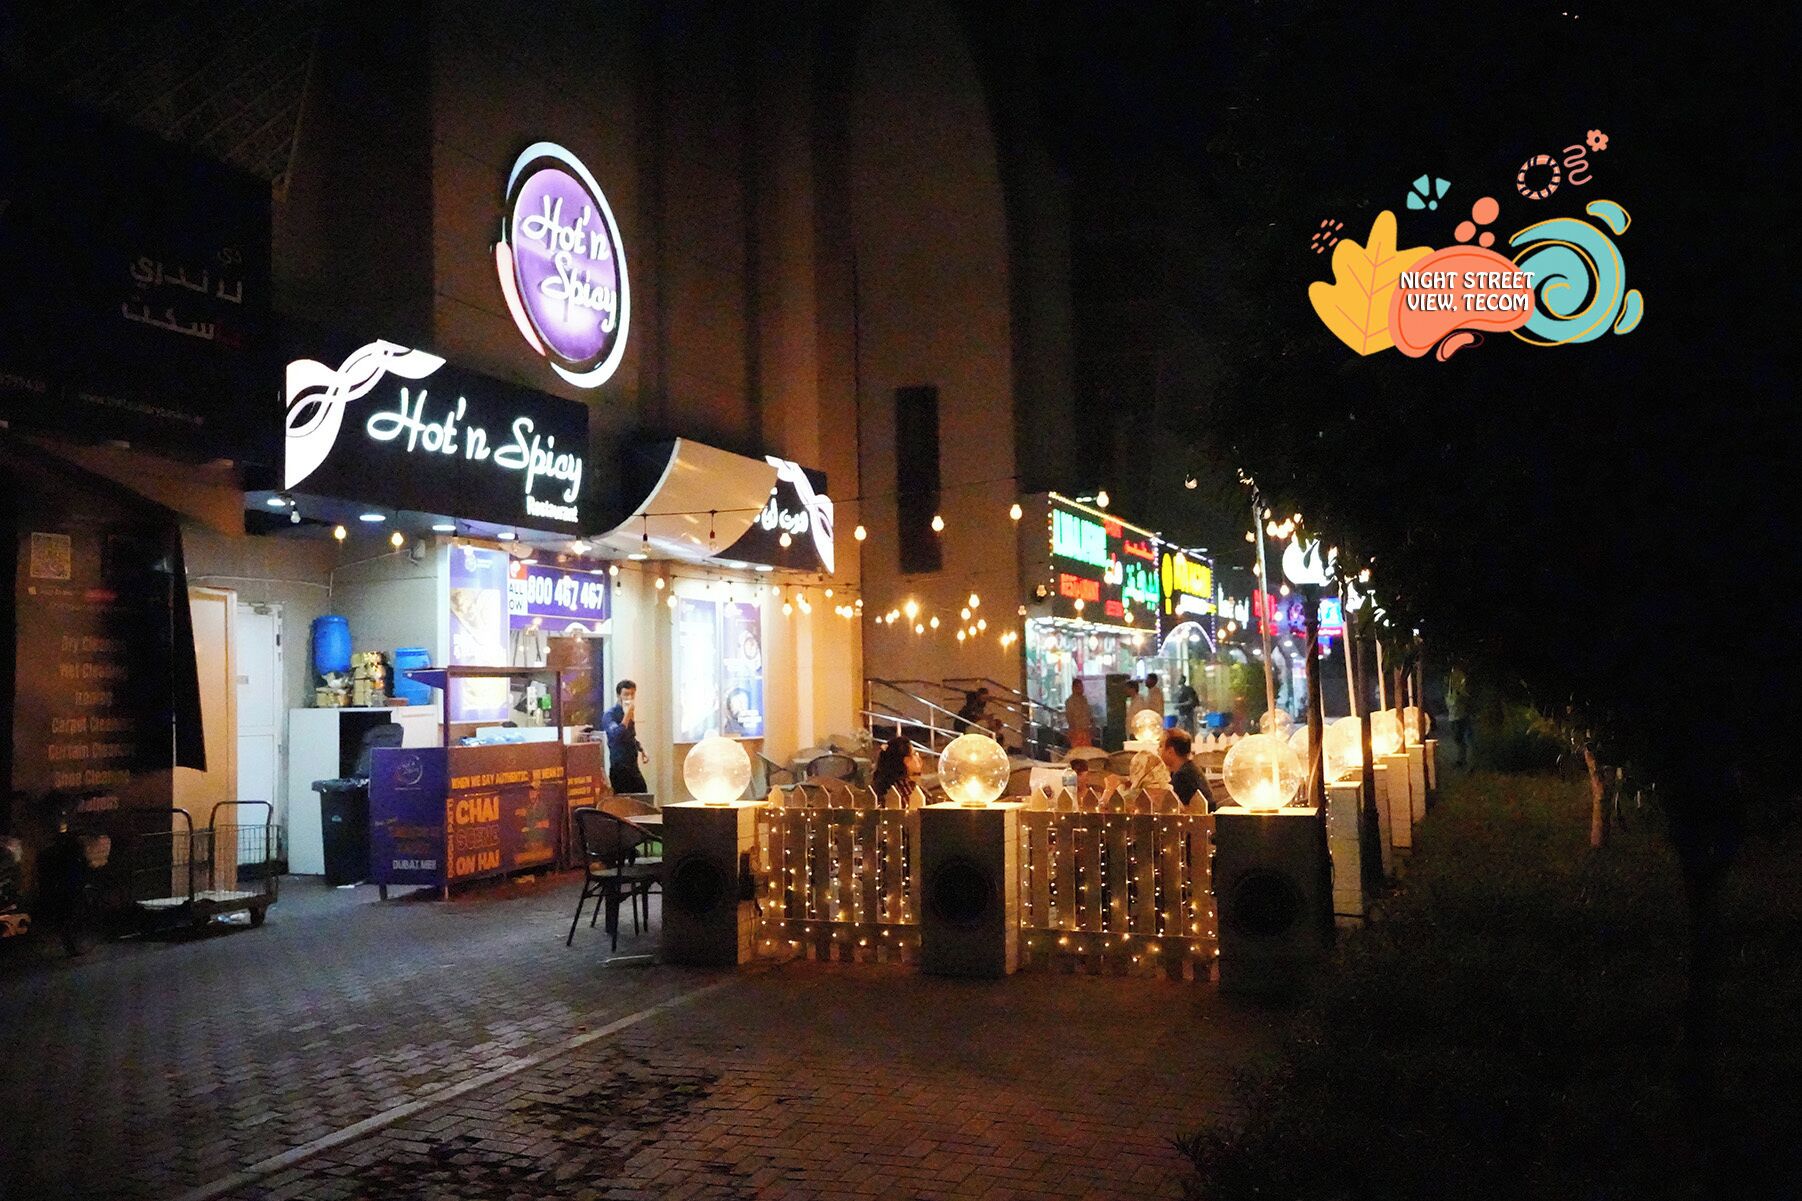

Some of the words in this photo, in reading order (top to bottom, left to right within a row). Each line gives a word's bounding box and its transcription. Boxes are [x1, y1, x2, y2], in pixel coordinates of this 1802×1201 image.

[523, 194, 609, 260] Hot'n
[541, 250, 617, 333] Spicy
[367, 387, 491, 460] Hot'n
[494, 416, 583, 503] Spicy
[527, 575, 553, 606] 800
[554, 576, 579, 608] 467
[580, 581, 604, 610] 467
[456, 796, 499, 825] CHAI
[456, 854, 475, 876] ON
[478, 849, 500, 871] HAI
